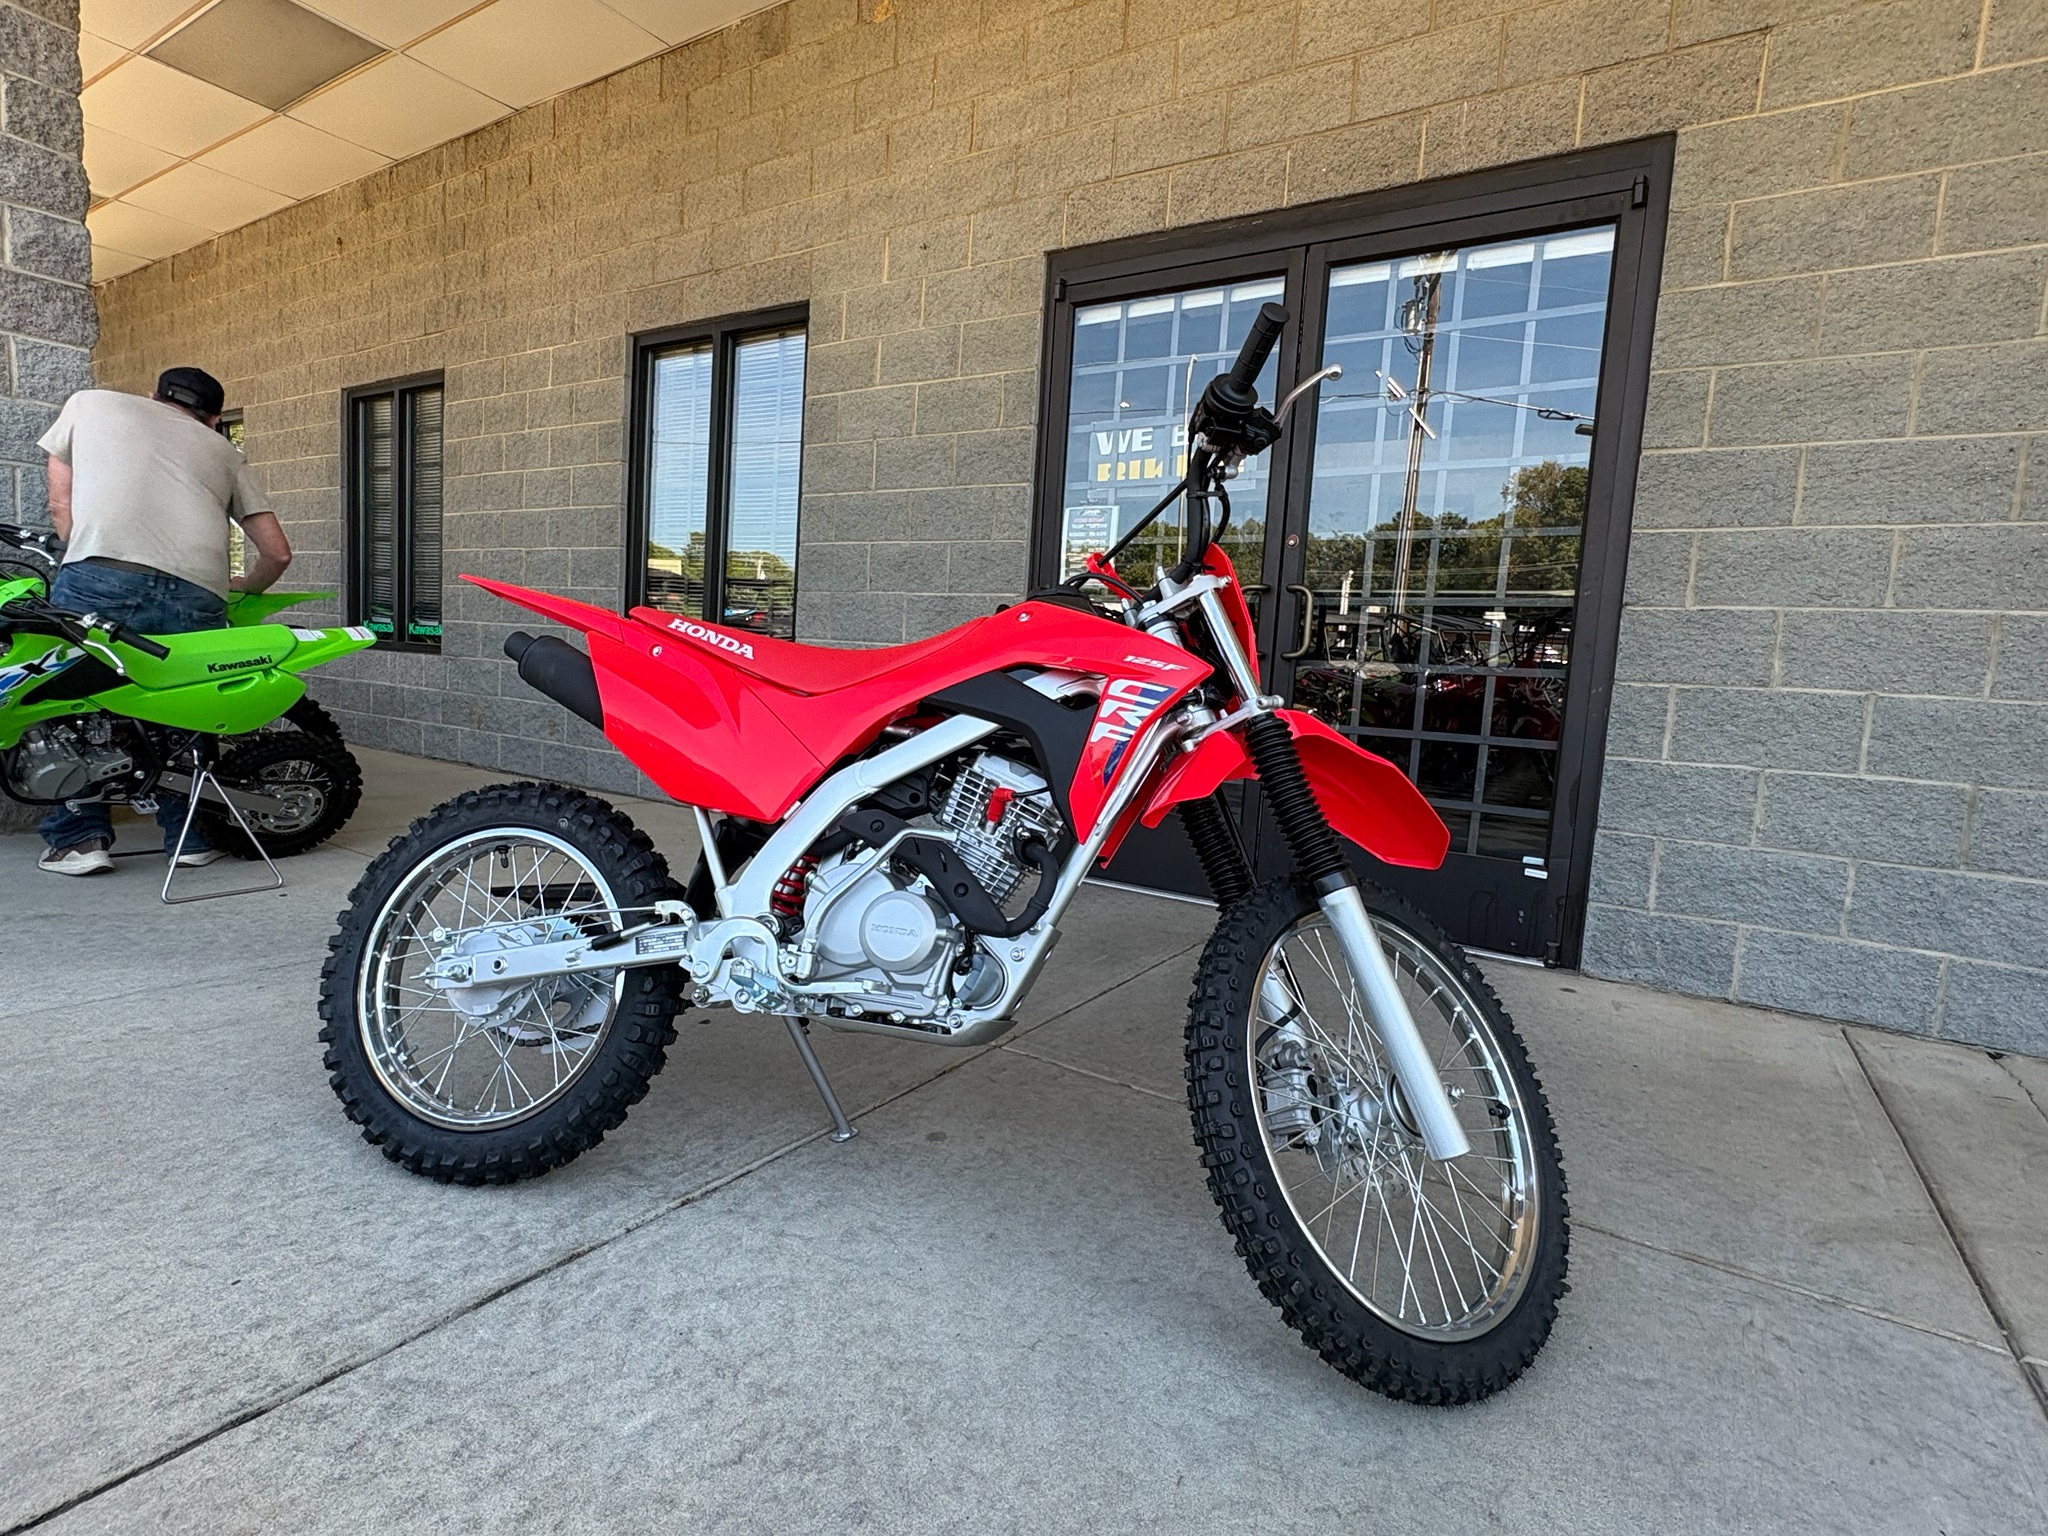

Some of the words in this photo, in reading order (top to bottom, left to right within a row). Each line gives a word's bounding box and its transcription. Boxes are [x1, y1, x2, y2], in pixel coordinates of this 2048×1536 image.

[1096, 426, 1154, 456] WE
[408, 622, 442, 636] Kawasak
[668, 618, 755, 660] HONDA
[207, 654, 273, 674] Kawasaki
[1123, 655, 1189, 671] 125F
[1090, 678, 1169, 743] CRF
[870, 923, 919, 938] HONDA
